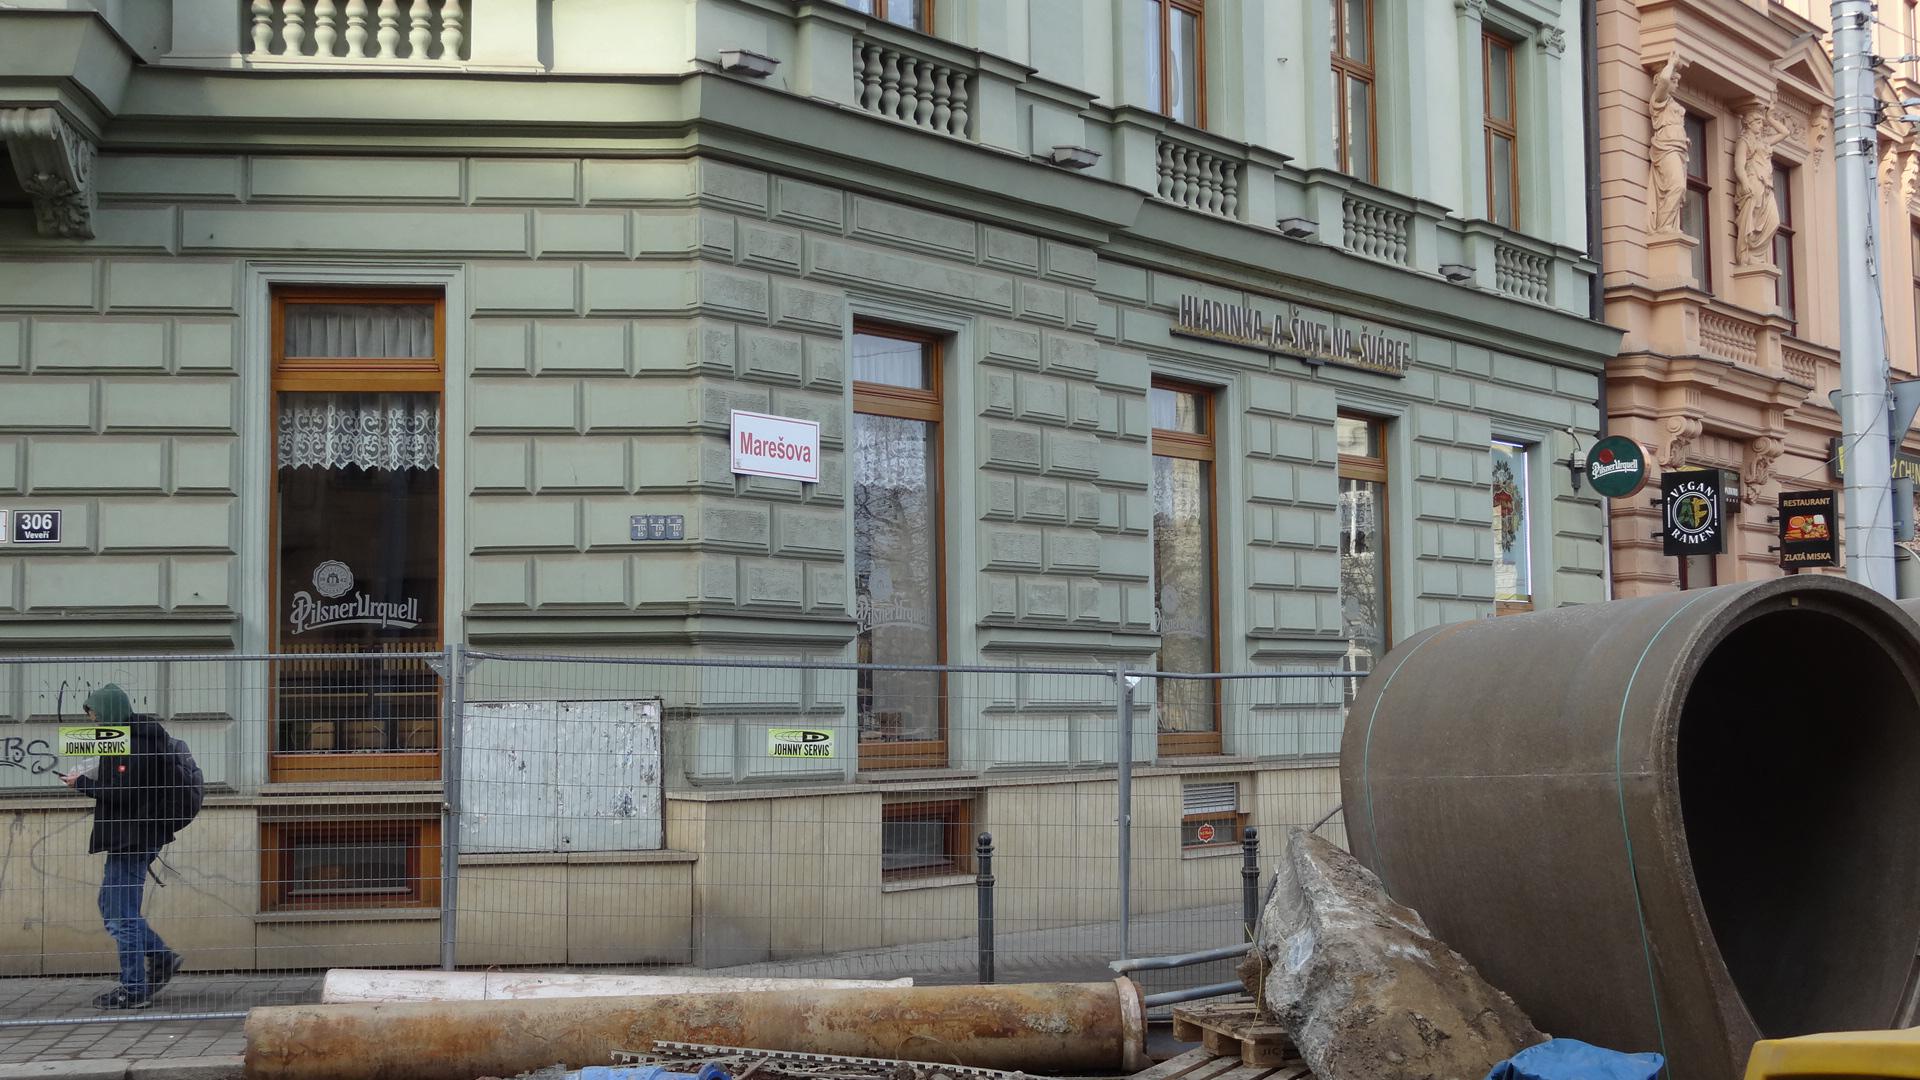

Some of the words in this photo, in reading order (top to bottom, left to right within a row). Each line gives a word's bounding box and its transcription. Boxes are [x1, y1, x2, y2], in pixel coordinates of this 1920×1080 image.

[1179, 294, 1263, 341] HLADINKA
[1271, 314, 1283, 345] A
[1289, 308, 1327, 353] ŠNYT
[1331, 327, 1351, 359] NA
[740, 431, 811, 463] Marešova
[1592, 461, 1616, 479] Pilsner
[1614, 459, 1638, 473] Urquell
[1670, 481, 1714, 498] VEGAN
[1783, 497, 1831, 507] RESTAURANT
[21, 514, 52, 530] 306
[1671, 526, 1715, 544] RAMEN
[1784, 552, 1806, 561] ZLATÁ
[1806, 552, 1831, 561] MISKA
[290, 591, 358, 634] Pilsner
[355, 591, 418, 629] Urquell
[65, 741, 96, 754] JOHNNY
[98, 741, 126, 754] SERVIS
[774, 743, 802, 756] JOHNNY
[803, 744, 830, 757] SERVIS
